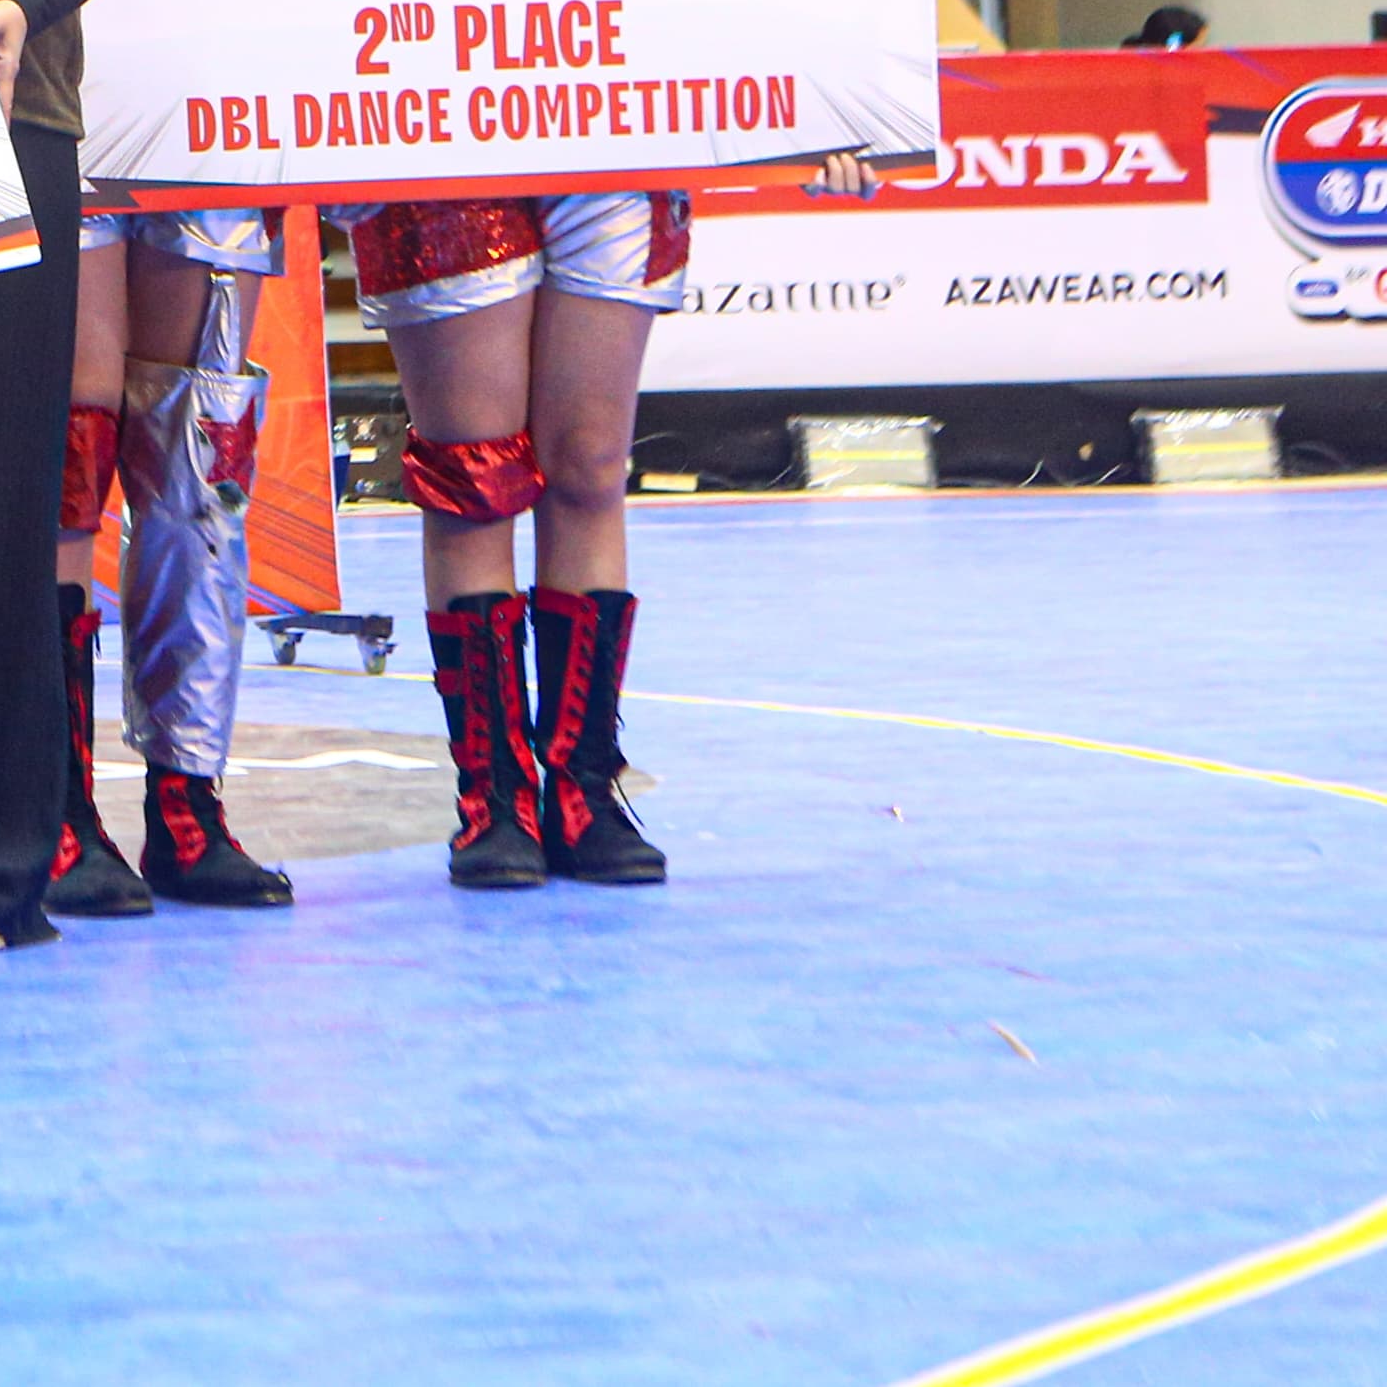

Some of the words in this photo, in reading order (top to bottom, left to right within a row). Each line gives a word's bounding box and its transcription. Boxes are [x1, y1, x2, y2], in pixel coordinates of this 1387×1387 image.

[353, 2, 436, 75] 2ND
[453, 0, 626, 72] PLACE
[186, 95, 281, 152] DBL
[293, 88, 453, 148] DANCE
[468, 75, 796, 142] COMPETITION
[872, 132, 1188, 192] NDA
[943, 269, 1228, 307] AZAWEAR.COM
